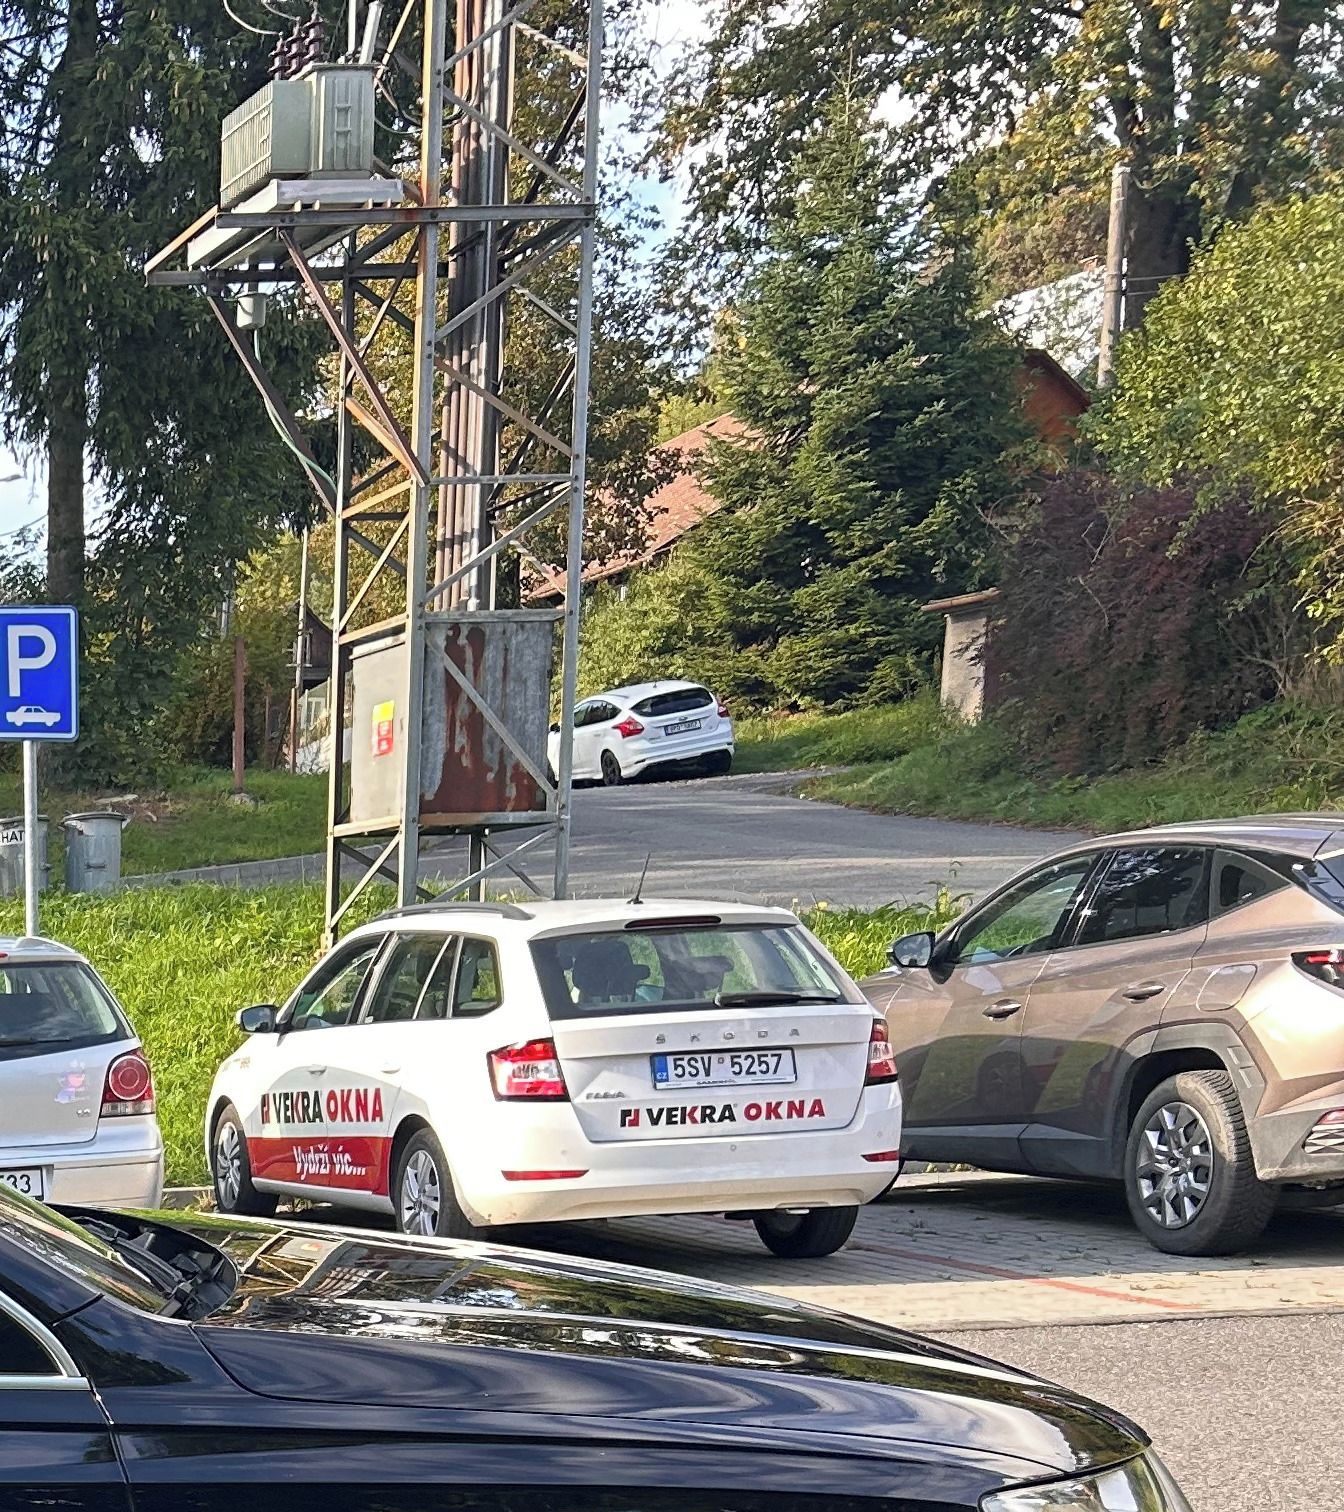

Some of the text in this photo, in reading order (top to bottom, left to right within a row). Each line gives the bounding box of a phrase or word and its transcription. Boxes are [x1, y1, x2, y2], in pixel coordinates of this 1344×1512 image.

[7, 624, 57, 697] P
[673, 1056, 712, 1079] 5SV
[730, 1053, 783, 1076] 5257
[273, 1087, 384, 1124] VEKRA OKNA
[646, 1098, 826, 1127] VEKRA OKNA
